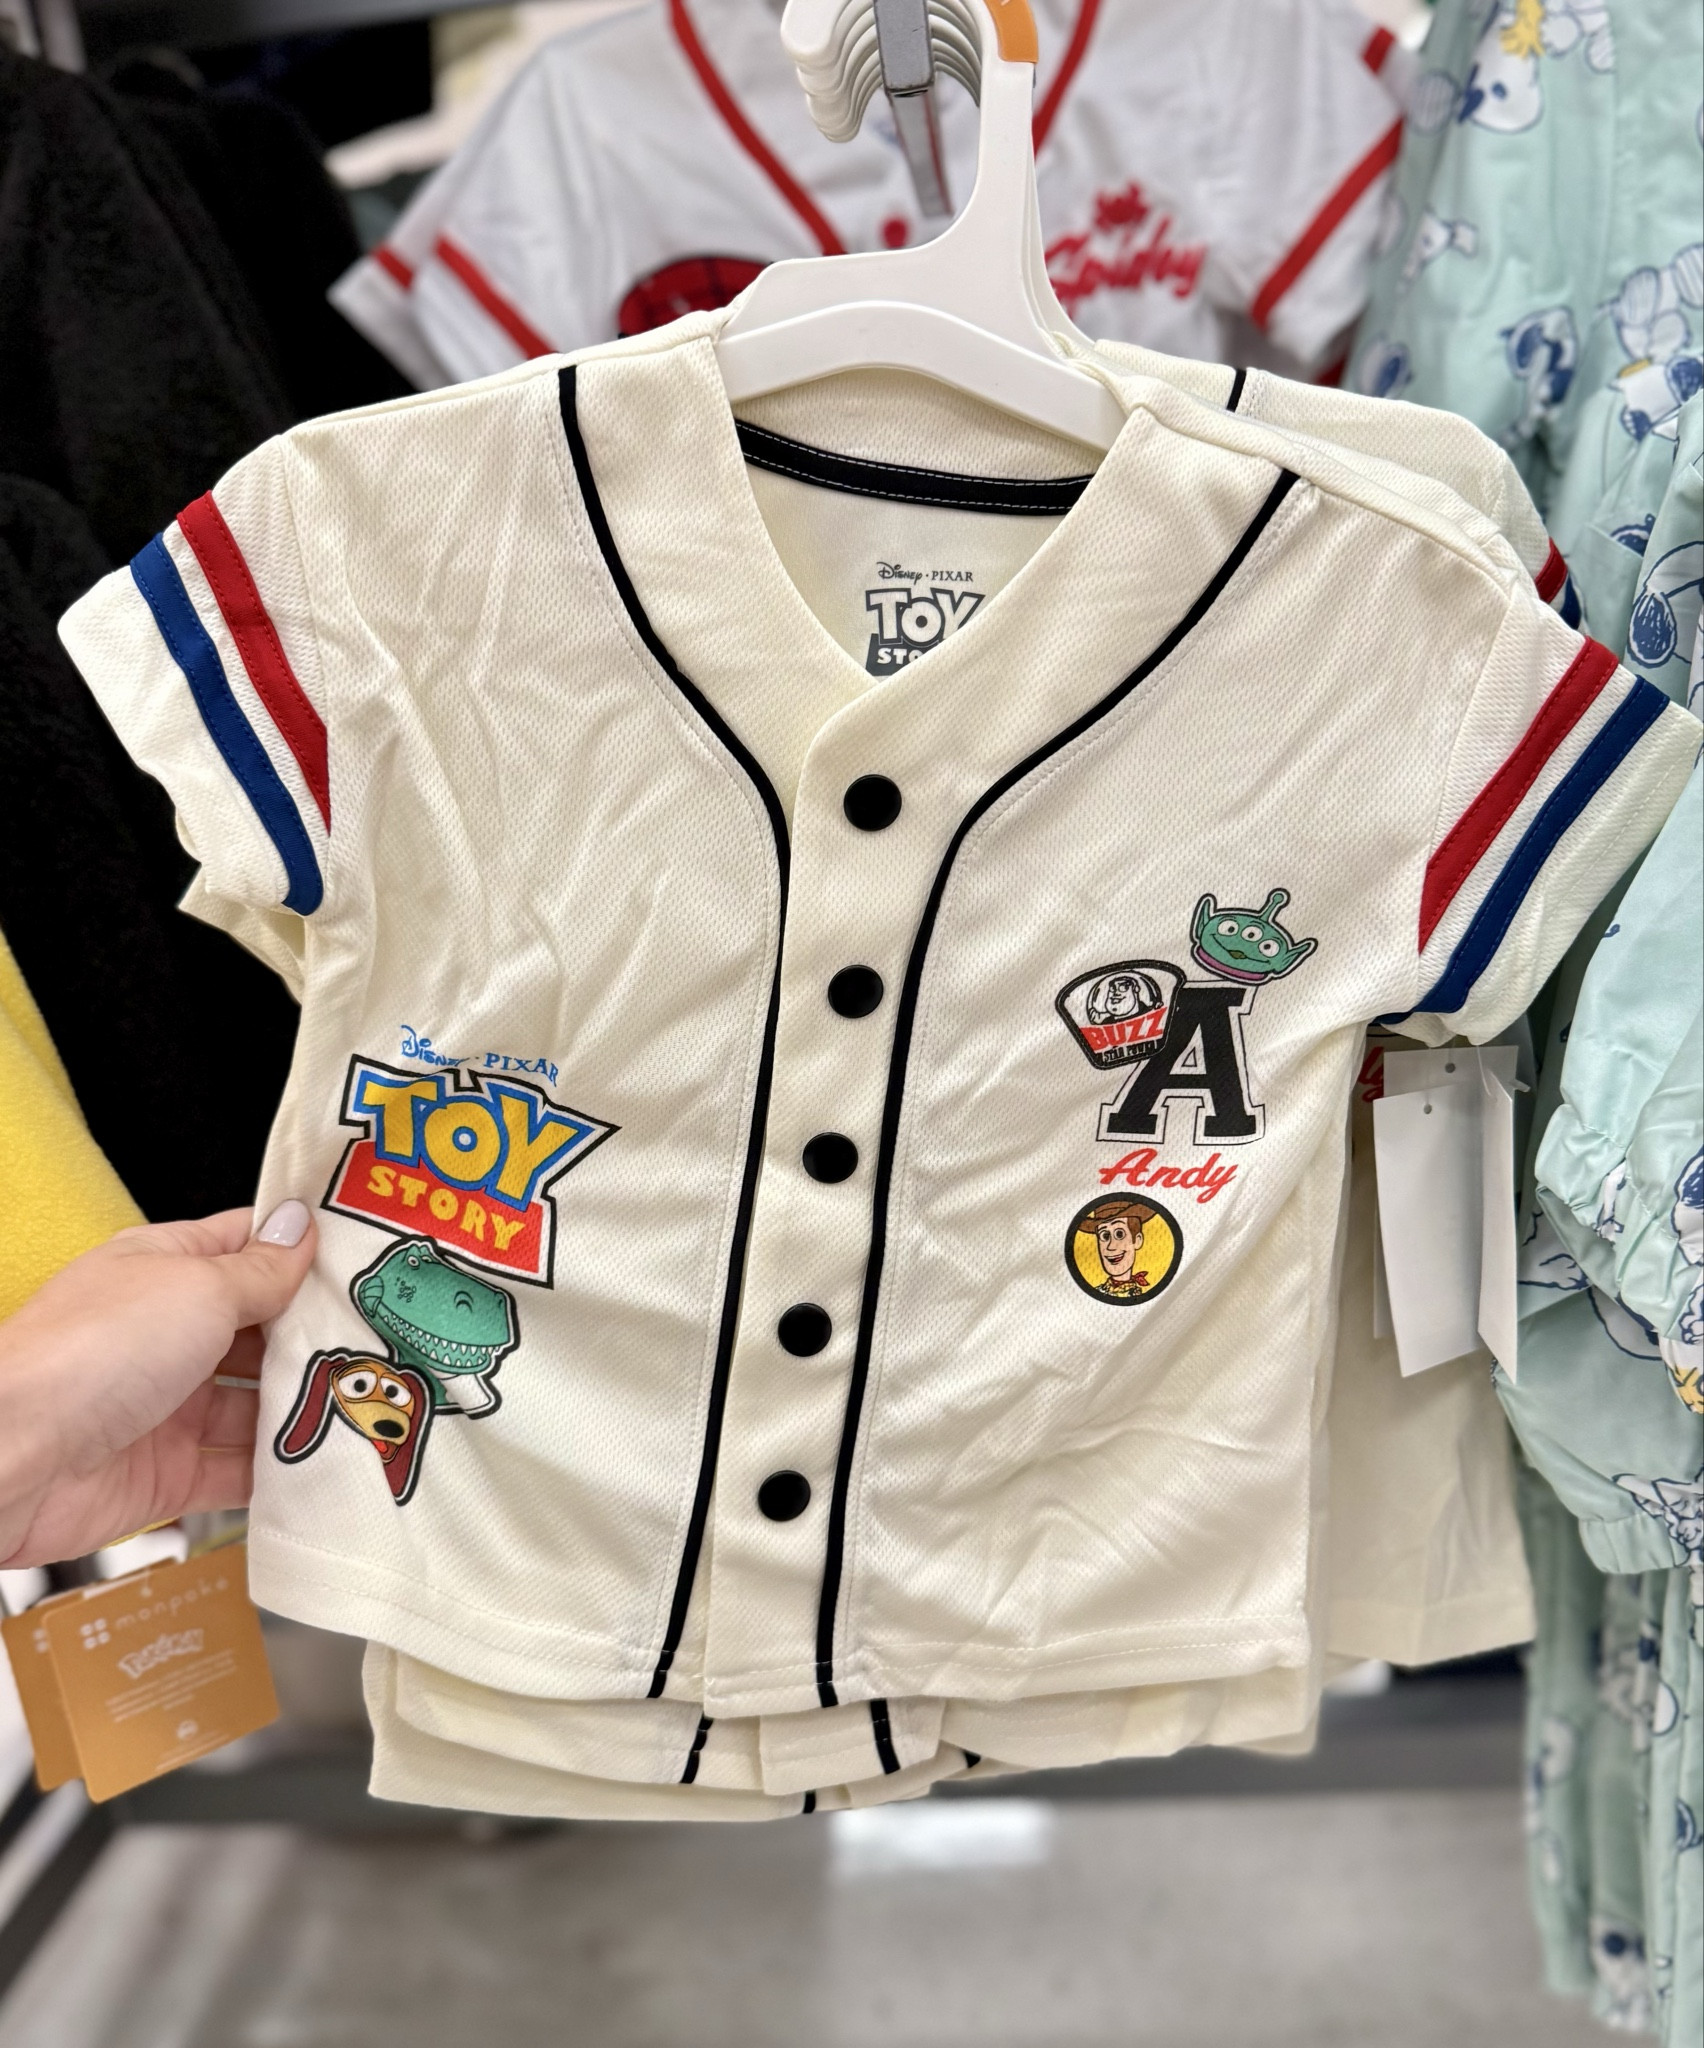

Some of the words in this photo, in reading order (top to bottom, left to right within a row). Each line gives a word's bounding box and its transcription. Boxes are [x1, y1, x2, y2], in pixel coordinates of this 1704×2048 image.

[931, 570, 974, 583] PIXAR
[865, 587, 986, 647] TOY
[876, 647, 924, 665] STO
[1080, 1007, 1168, 1053] BUZZ
[484, 1052, 559, 1087] PIXAR
[1097, 980, 1265, 1145] A
[353, 1070, 595, 1213] TOY
[1098, 1147, 1239, 1204] Andy
[367, 1165, 526, 1251] STORY
